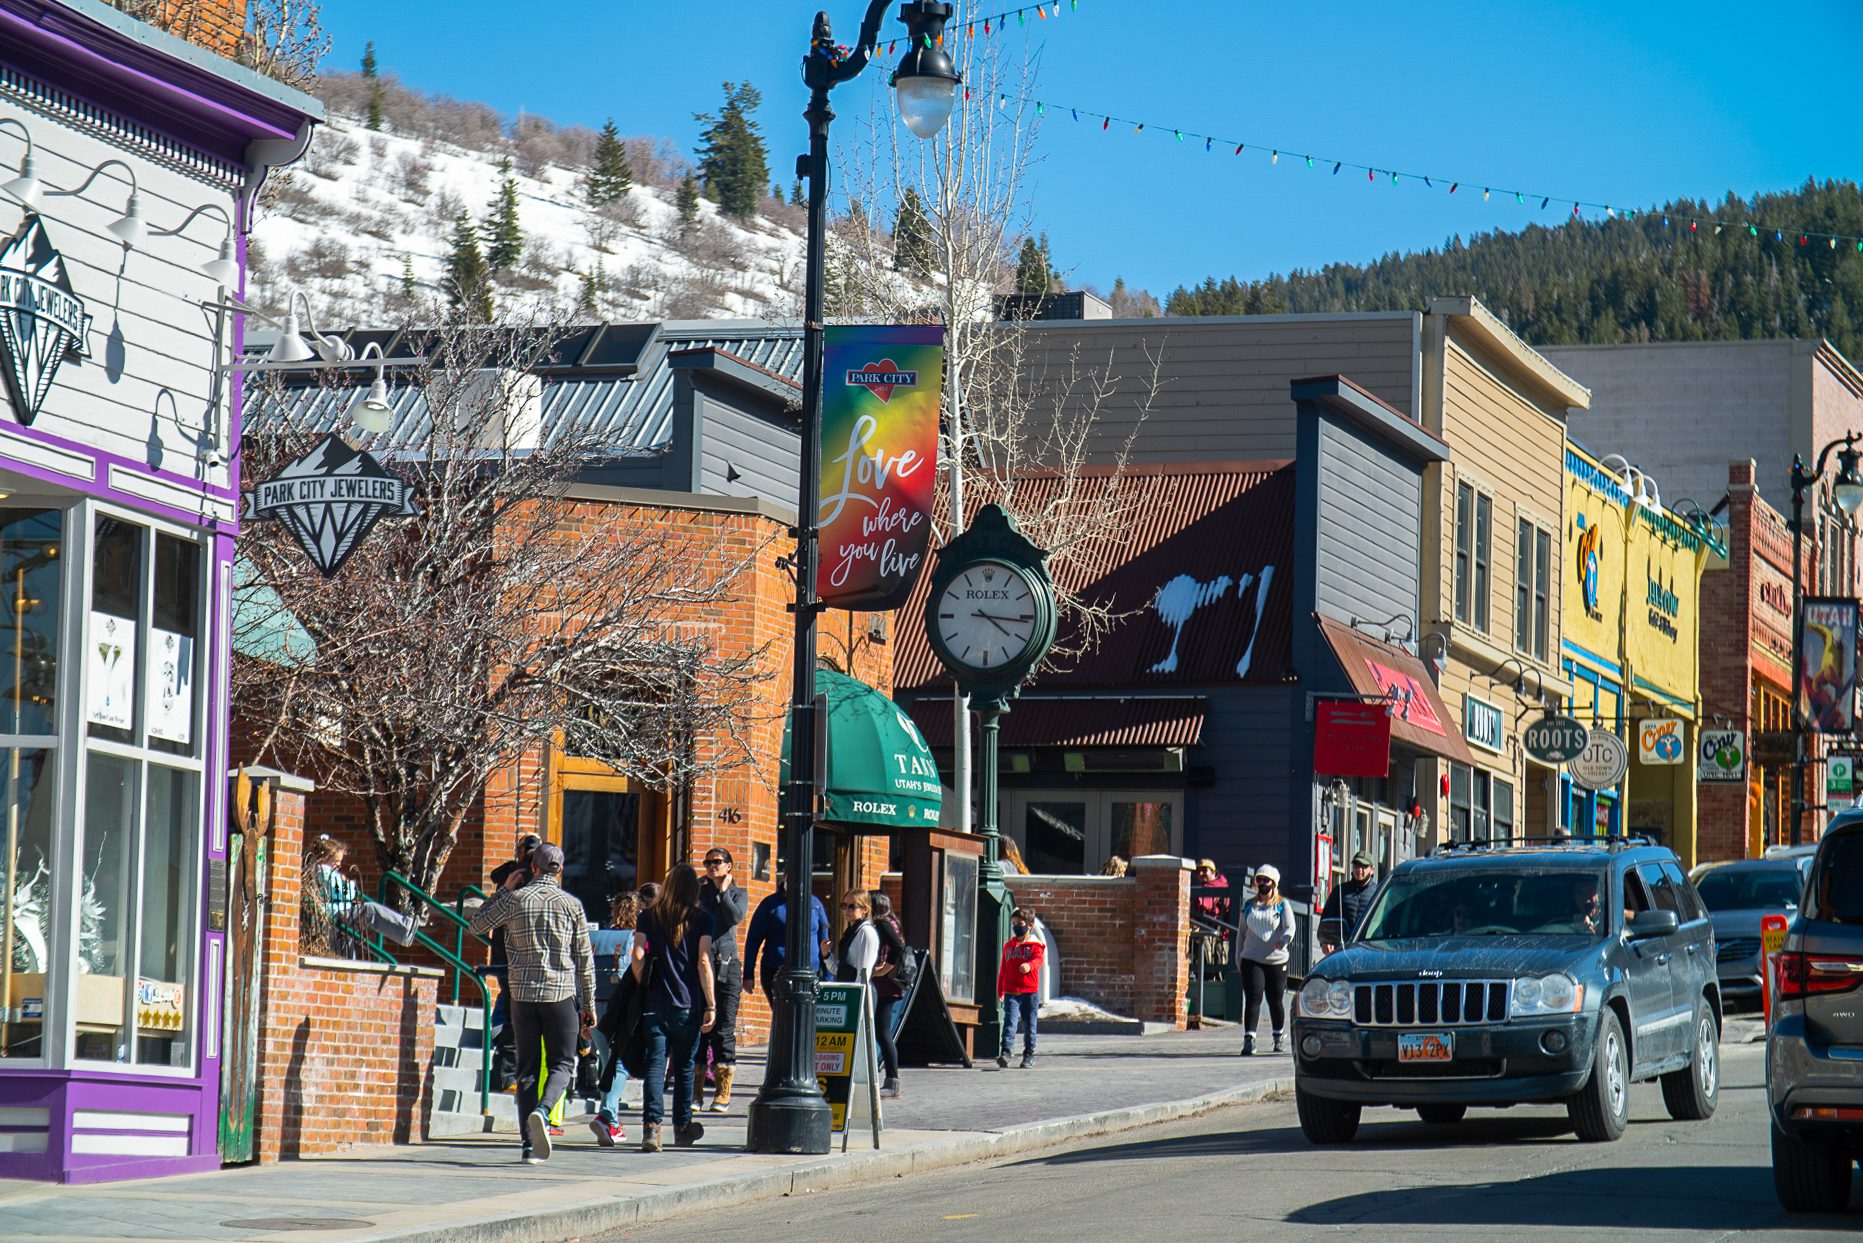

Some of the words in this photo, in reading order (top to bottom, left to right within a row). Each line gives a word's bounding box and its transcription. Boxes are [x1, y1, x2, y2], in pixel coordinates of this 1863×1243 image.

[15, 277, 33, 308] CITY
[35, 284, 79, 331] JEWELERS
[851, 373, 880, 383] PARK
[883, 373, 913, 383] CITY
[819, 414, 925, 528] Love
[264, 482, 295, 506] PARK
[299, 479, 327, 499] CITY
[330, 478, 395, 501] JEWELERS
[862, 497, 923, 538] where
[830, 541, 880, 587] you
[879, 539, 921, 577] live
[966, 590, 1009, 600] ROLEX
[1807, 605, 1853, 628] UTAH
[1528, 729, 1584, 749] ROOTS
[1583, 744, 1613, 764] OTC
[895, 779, 922, 791] UTAH'S
[717, 807, 742, 824] 416
[853, 801, 897, 816] ROLEX
[923, 808, 940, 821] ROLE
[1005, 945, 1032, 961] GAP
[823, 991, 829, 1001] 5
[830, 991, 847, 1001] PM
[816, 1016, 843, 1024] ARKING
[828, 1036, 847, 1046] AM
[821, 1062, 841, 1072] ONLY
